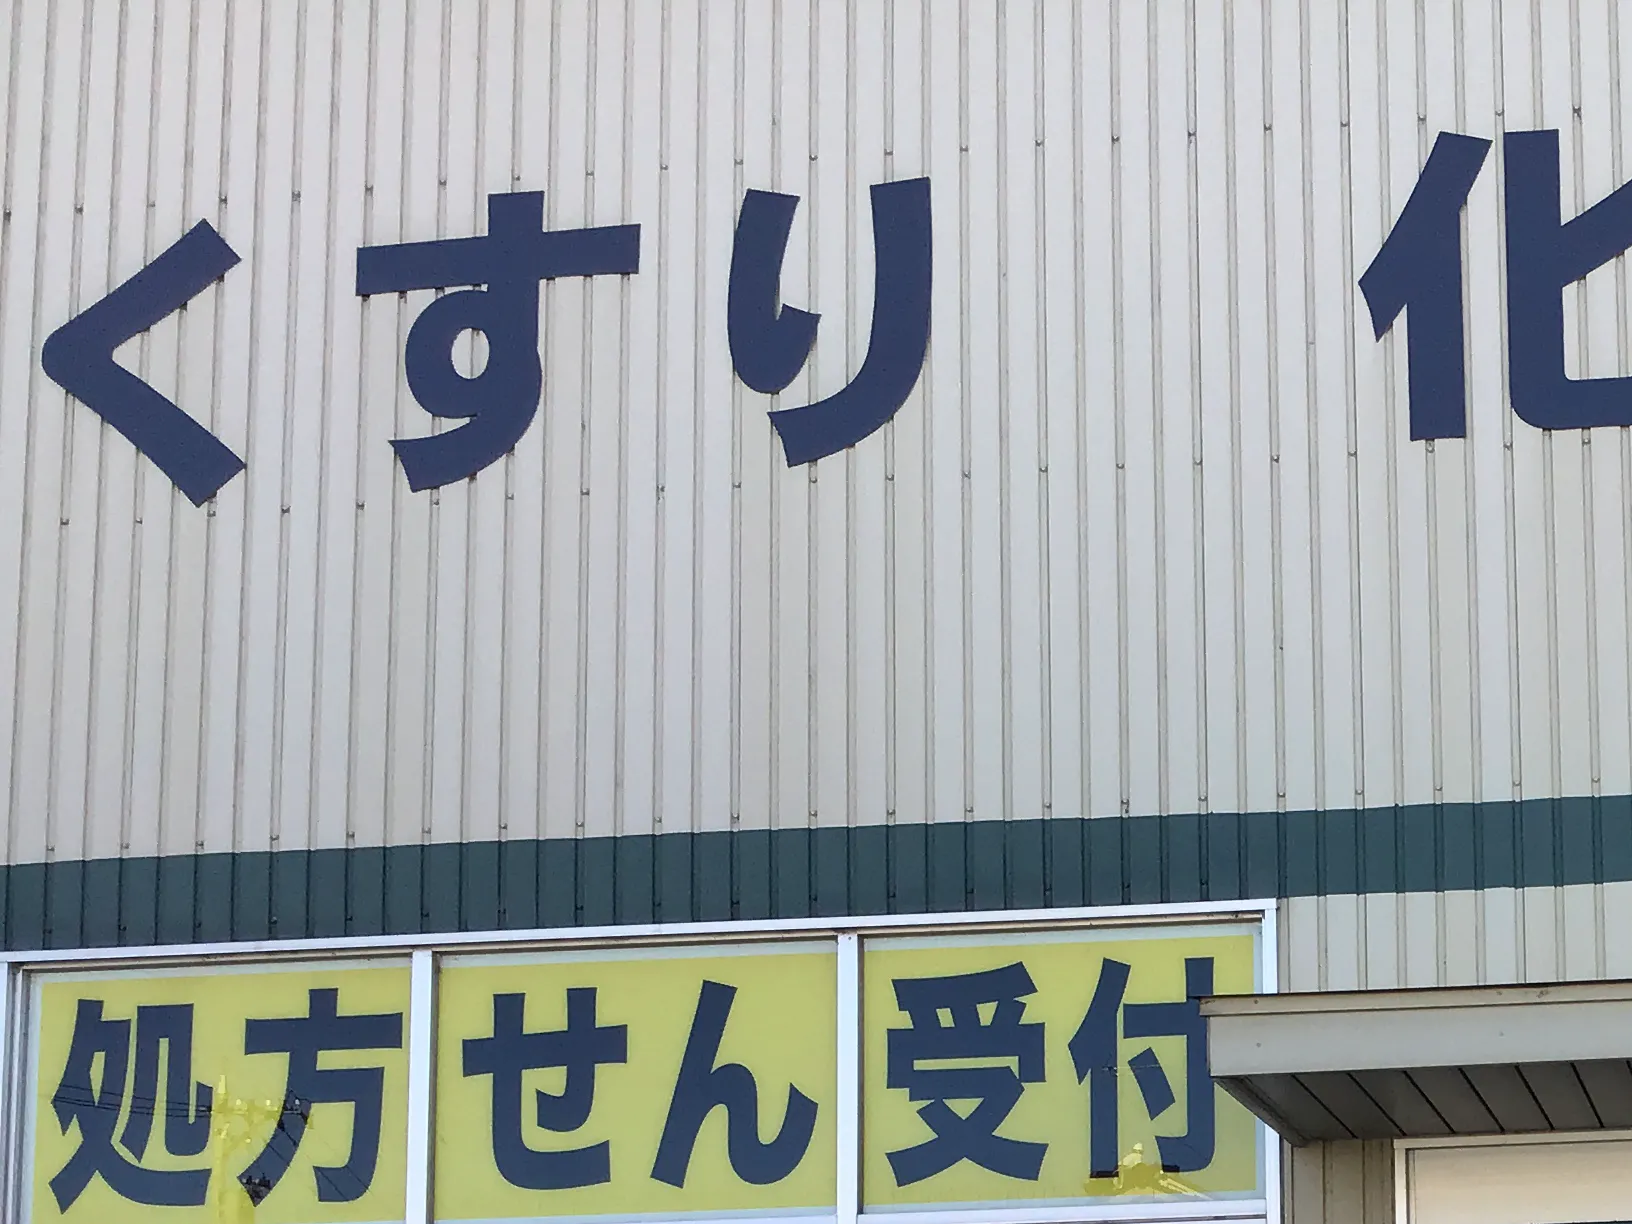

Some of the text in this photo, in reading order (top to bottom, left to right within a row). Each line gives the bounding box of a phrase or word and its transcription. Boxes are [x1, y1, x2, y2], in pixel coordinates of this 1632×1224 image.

[42, 177, 933, 508] くすり
[49, 956, 1216, 1215] 処方せん受付
